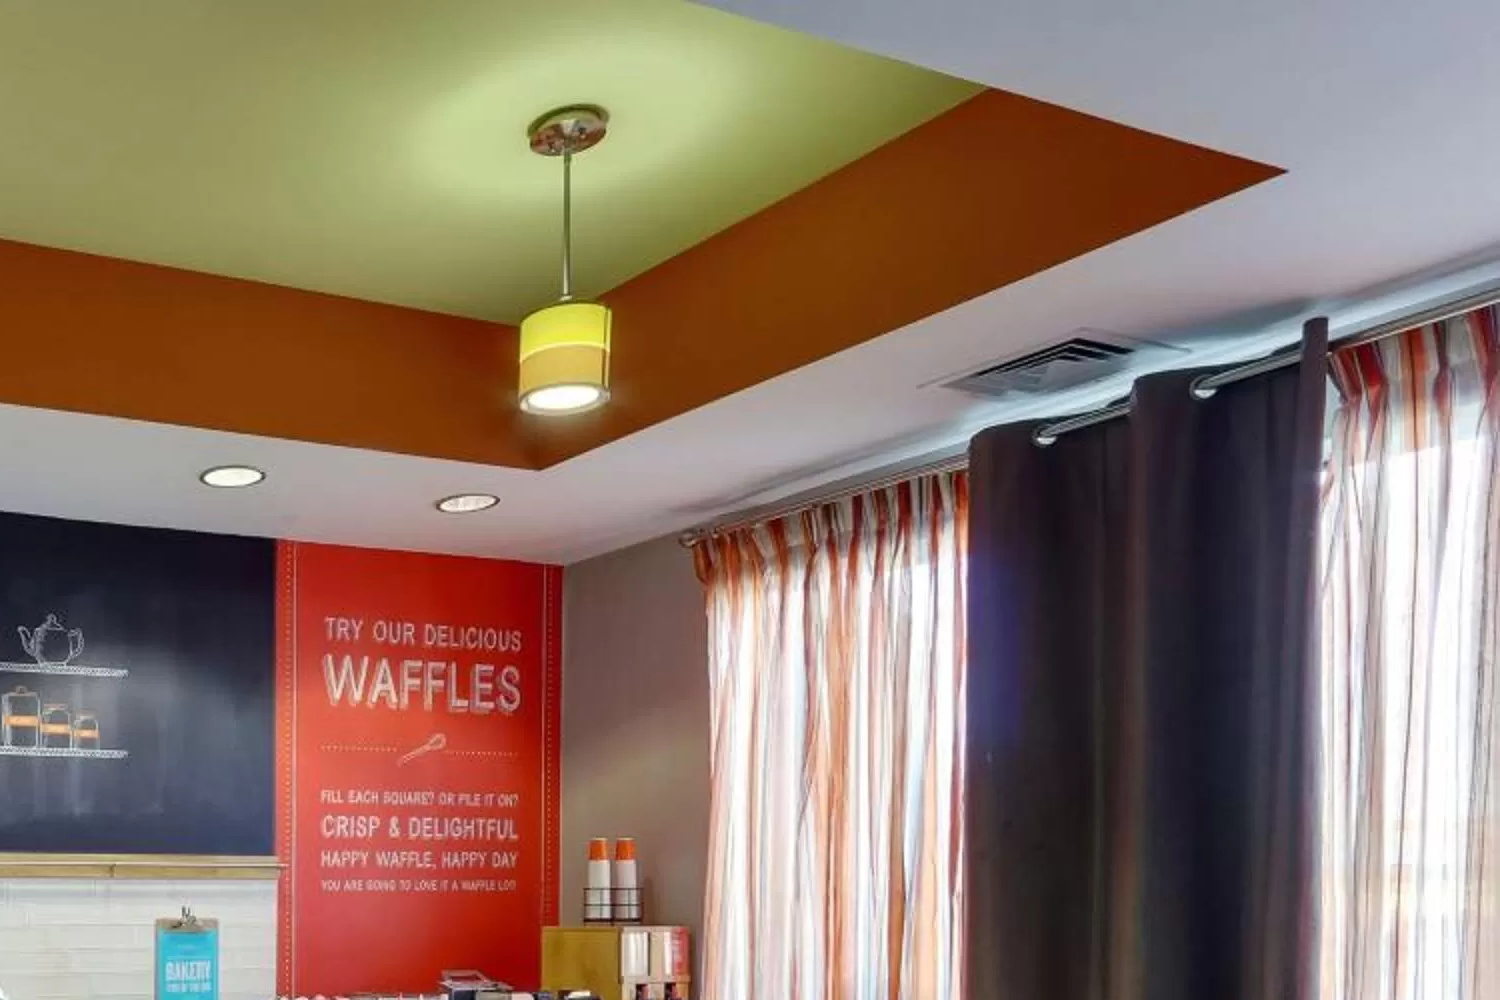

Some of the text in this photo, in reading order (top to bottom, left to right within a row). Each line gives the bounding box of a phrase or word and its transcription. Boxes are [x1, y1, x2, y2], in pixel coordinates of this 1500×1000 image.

[324, 616, 522, 651] TRY OUR DELICIOUS
[323, 653, 522, 715] WAFFLES
[320, 789, 344, 804] FILL
[347, 789, 379, 805] EACH
[439, 792, 456, 806] OR
[458, 793, 481, 807] PILE
[484, 793, 496, 807] IT
[321, 815, 519, 841] CRISP & DELIGHTFUL
[321, 851, 518, 870] HAPPY WAFFLE, HAPPY DAY
[321, 879, 341, 892] YOU
[343, 879, 364, 892] ARE
[366, 879, 397, 892] GOING
[400, 879, 412, 892] TO
[414, 879, 438, 892] LOVE
[440, 879, 449, 892] IT
[451, 879, 459, 892] A
